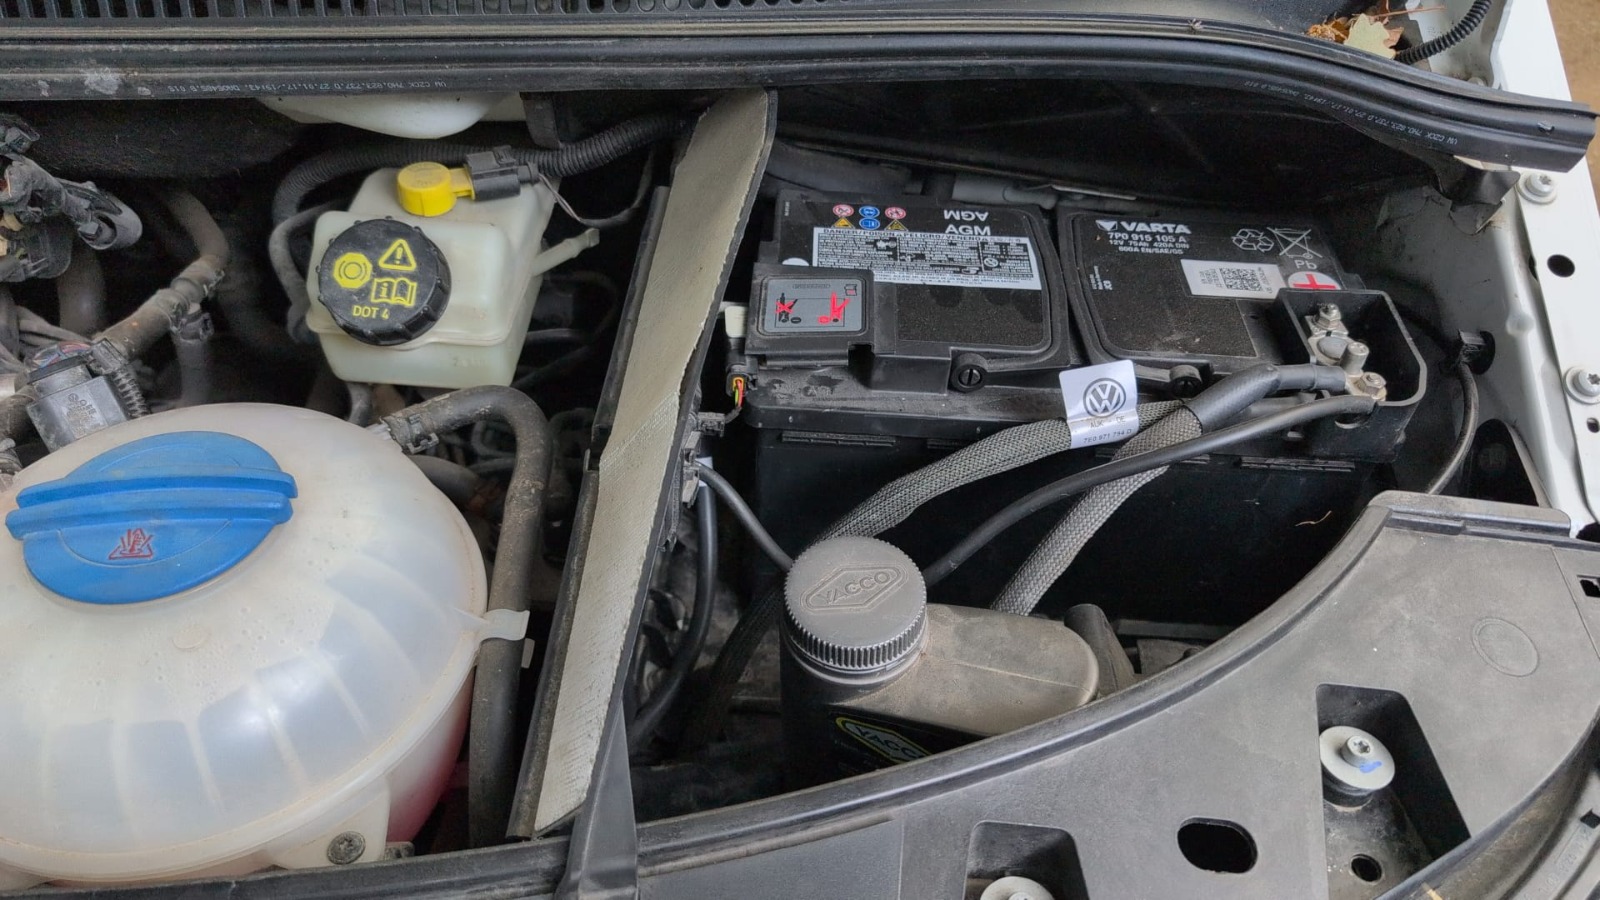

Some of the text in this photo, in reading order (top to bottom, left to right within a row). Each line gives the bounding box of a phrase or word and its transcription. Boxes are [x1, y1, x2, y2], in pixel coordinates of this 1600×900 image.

[1446, 136, 1458, 145] VW
[943, 209, 989, 222] AGM
[945, 224, 991, 236] AGM
[1120, 221, 1192, 235] VARTA
[1107, 232, 1187, 243] 7P0 915 105 A
[1294, 259, 1318, 271] Pb
[352, 304, 390, 320] DOT 4
[816, 575, 892, 605] YACCO
[855, 726, 925, 759] YACC
